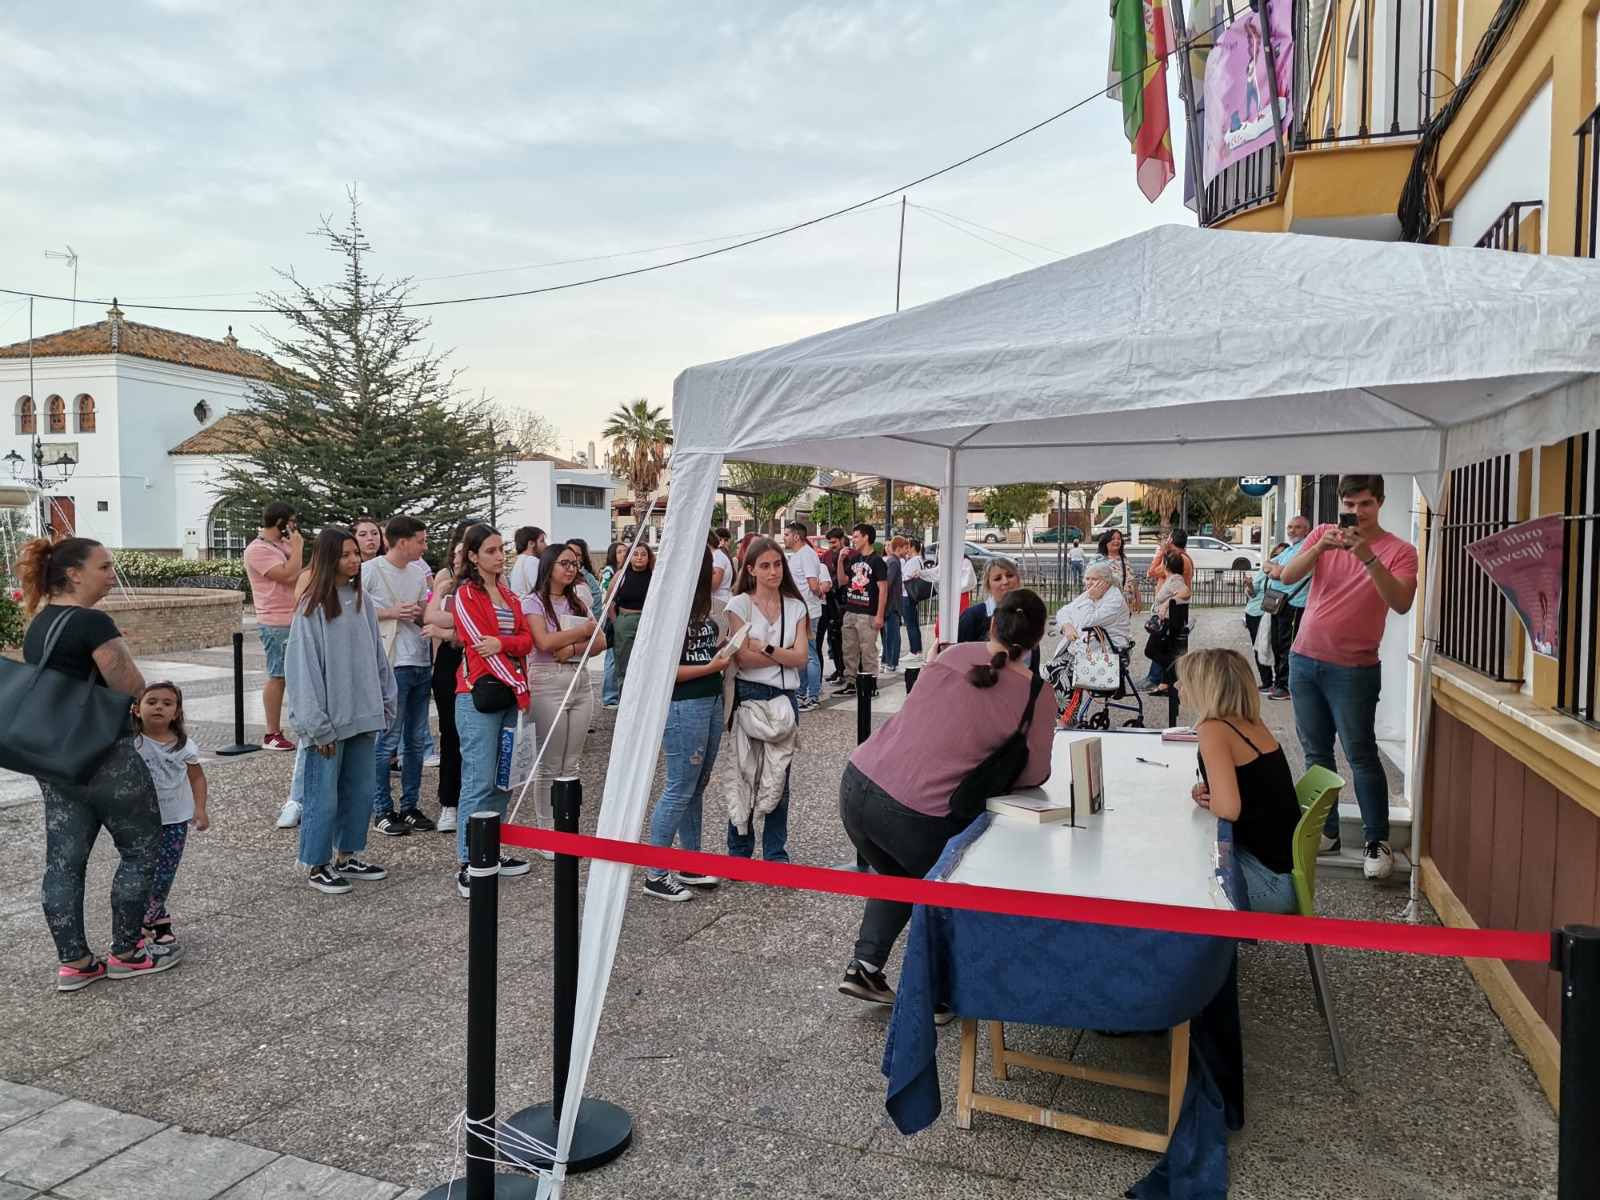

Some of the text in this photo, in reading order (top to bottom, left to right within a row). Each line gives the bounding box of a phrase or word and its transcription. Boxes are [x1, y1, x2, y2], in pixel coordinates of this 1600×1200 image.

[1240, 477, 1271, 485] DIGI
[1503, 528, 1543, 547] libro
[1483, 541, 1545, 572] juvenil
